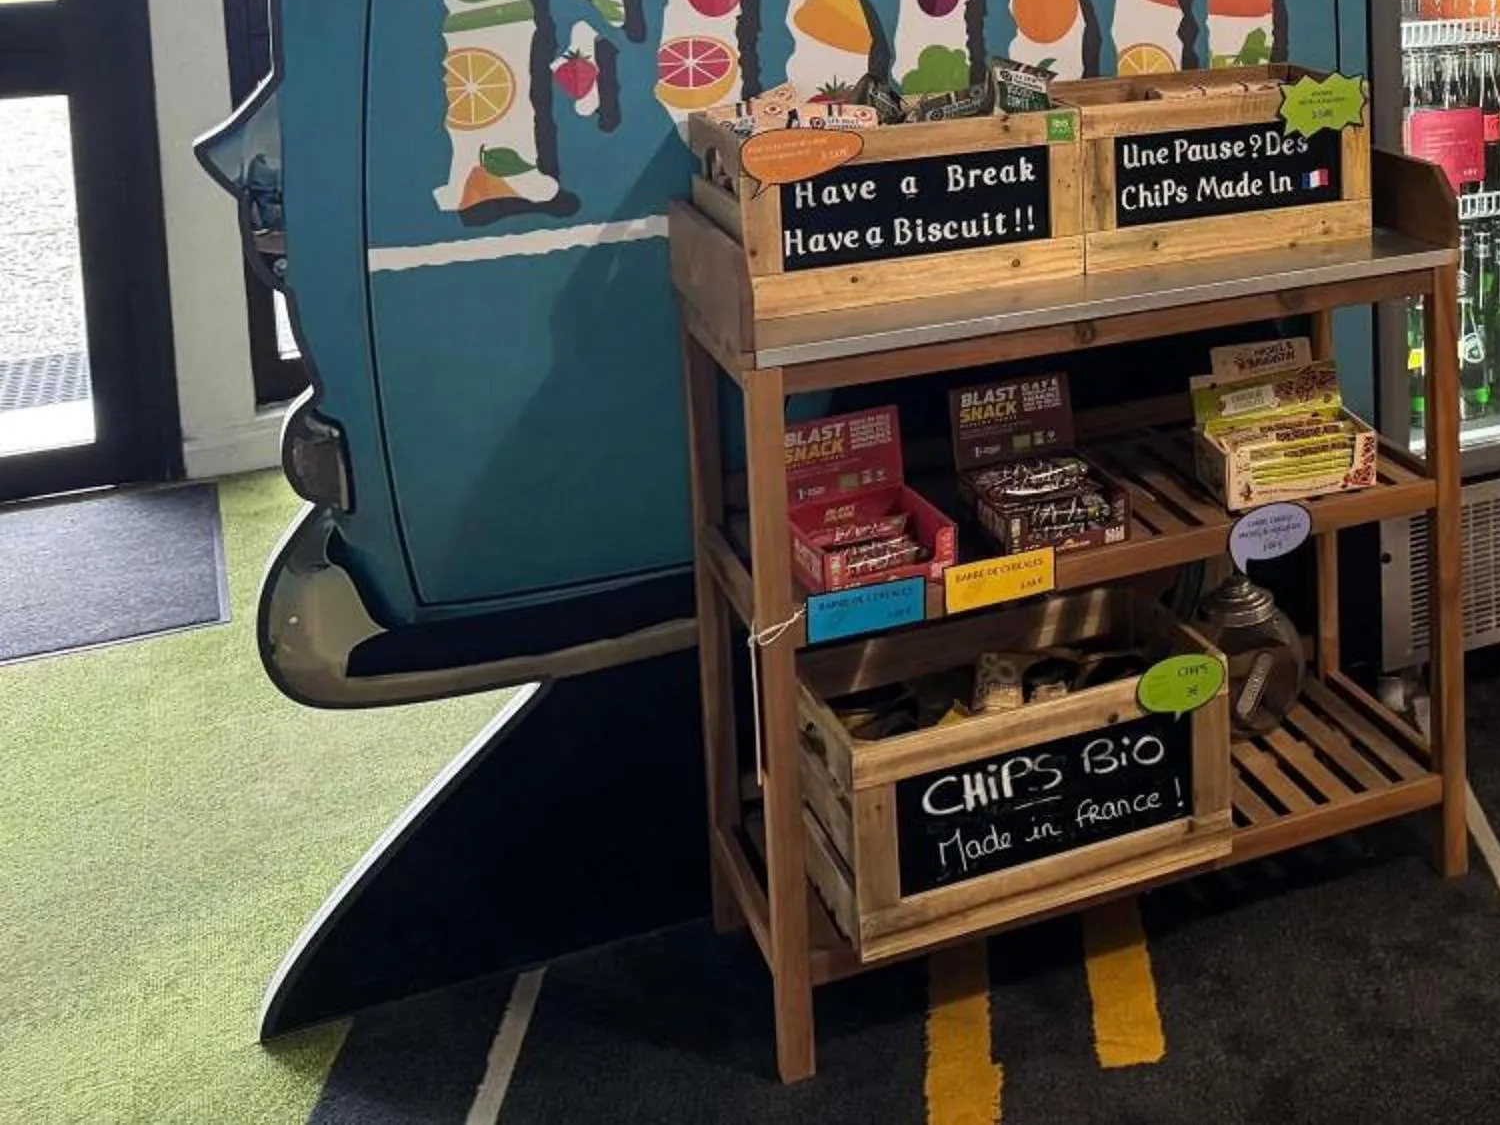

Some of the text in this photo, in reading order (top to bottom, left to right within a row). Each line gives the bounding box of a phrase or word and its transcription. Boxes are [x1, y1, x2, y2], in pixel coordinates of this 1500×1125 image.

[1123, 143, 1169, 168] Une
[1266, 131, 1308, 156] Des
[795, 156, 1036, 210] Have a Break
[1197, 171, 1263, 202] Made
[1269, 170, 1293, 194] In
[784, 228, 860, 257] Have
[866, 226, 884, 247] a
[893, 211, 1008, 246] Biscuit
[960, 400, 1018, 424] SNACK
[961, 384, 1018, 408] BLAST
[784, 422, 845, 448] BLAST
[784, 437, 845, 464] SNACK
[938, 824, 1012, 872] Made
[1025, 816, 1063, 842] in
